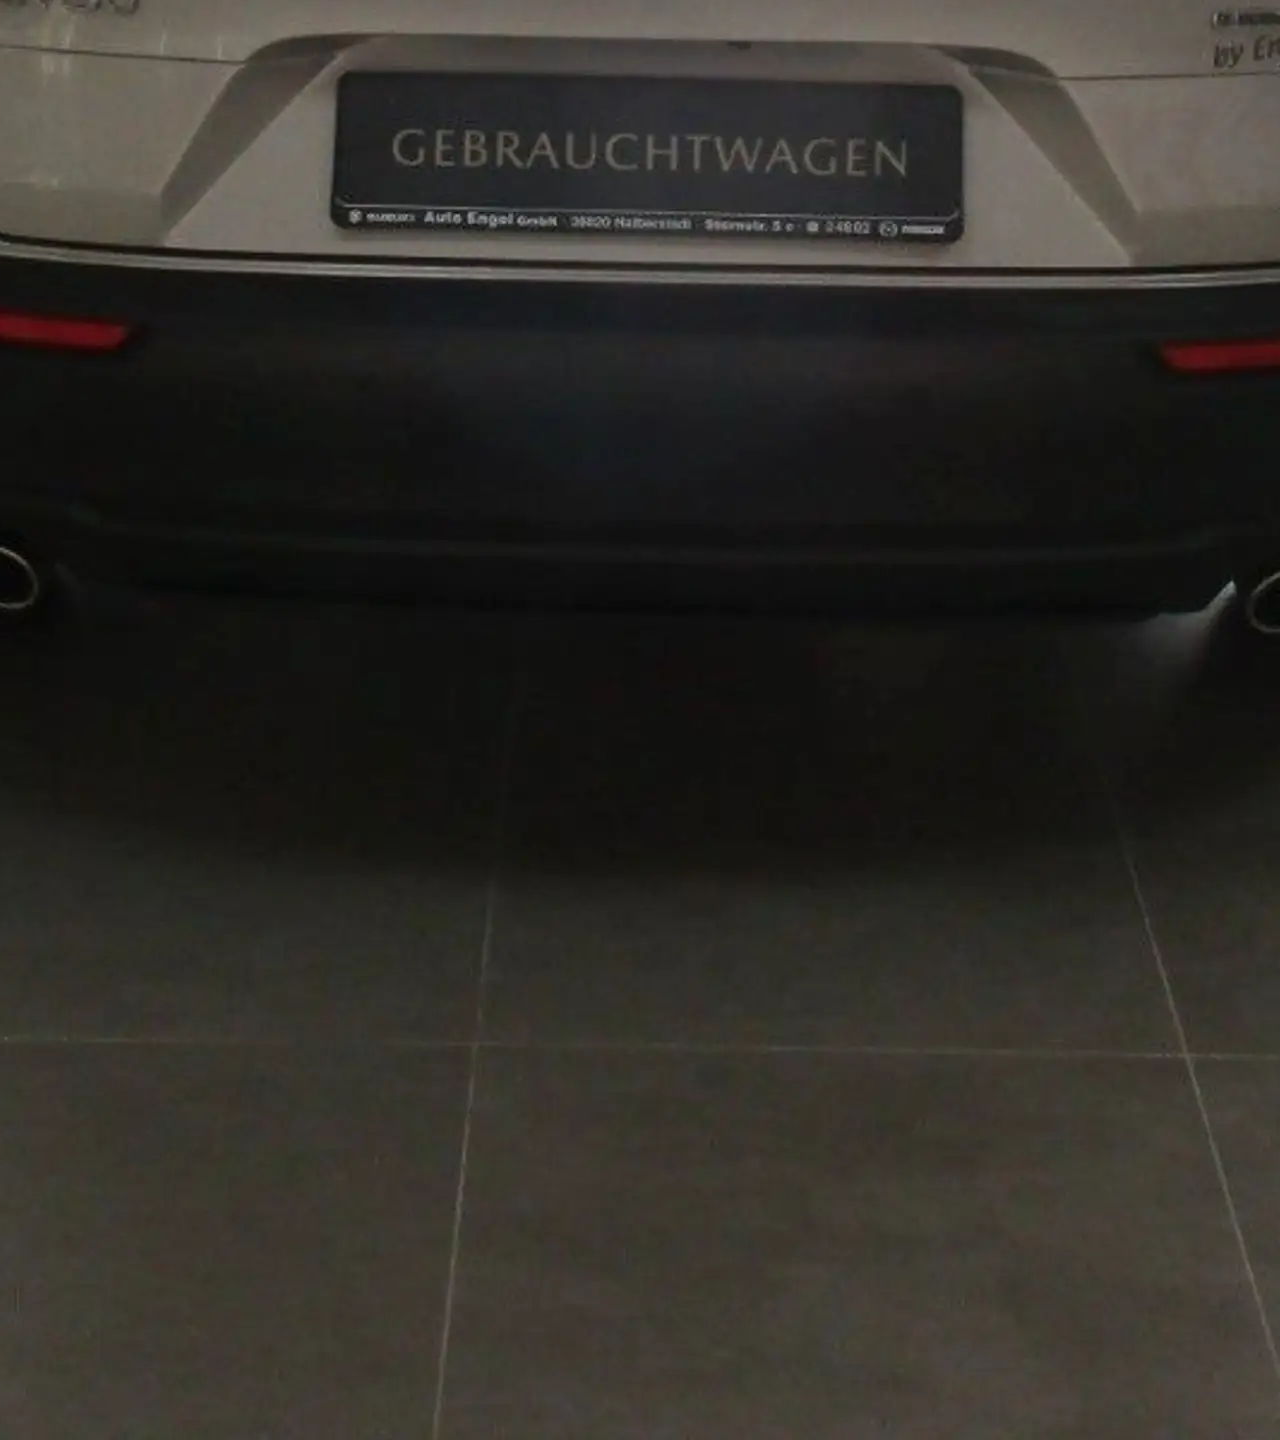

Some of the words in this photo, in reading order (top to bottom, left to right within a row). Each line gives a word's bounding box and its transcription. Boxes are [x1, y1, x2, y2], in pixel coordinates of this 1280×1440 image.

[1213, 40, 1244, 68] by
[391, 128, 908, 178] GEBRAUCHTWAGEN
[423, 211, 462, 225] Auto
[466, 212, 514, 228] Engel
